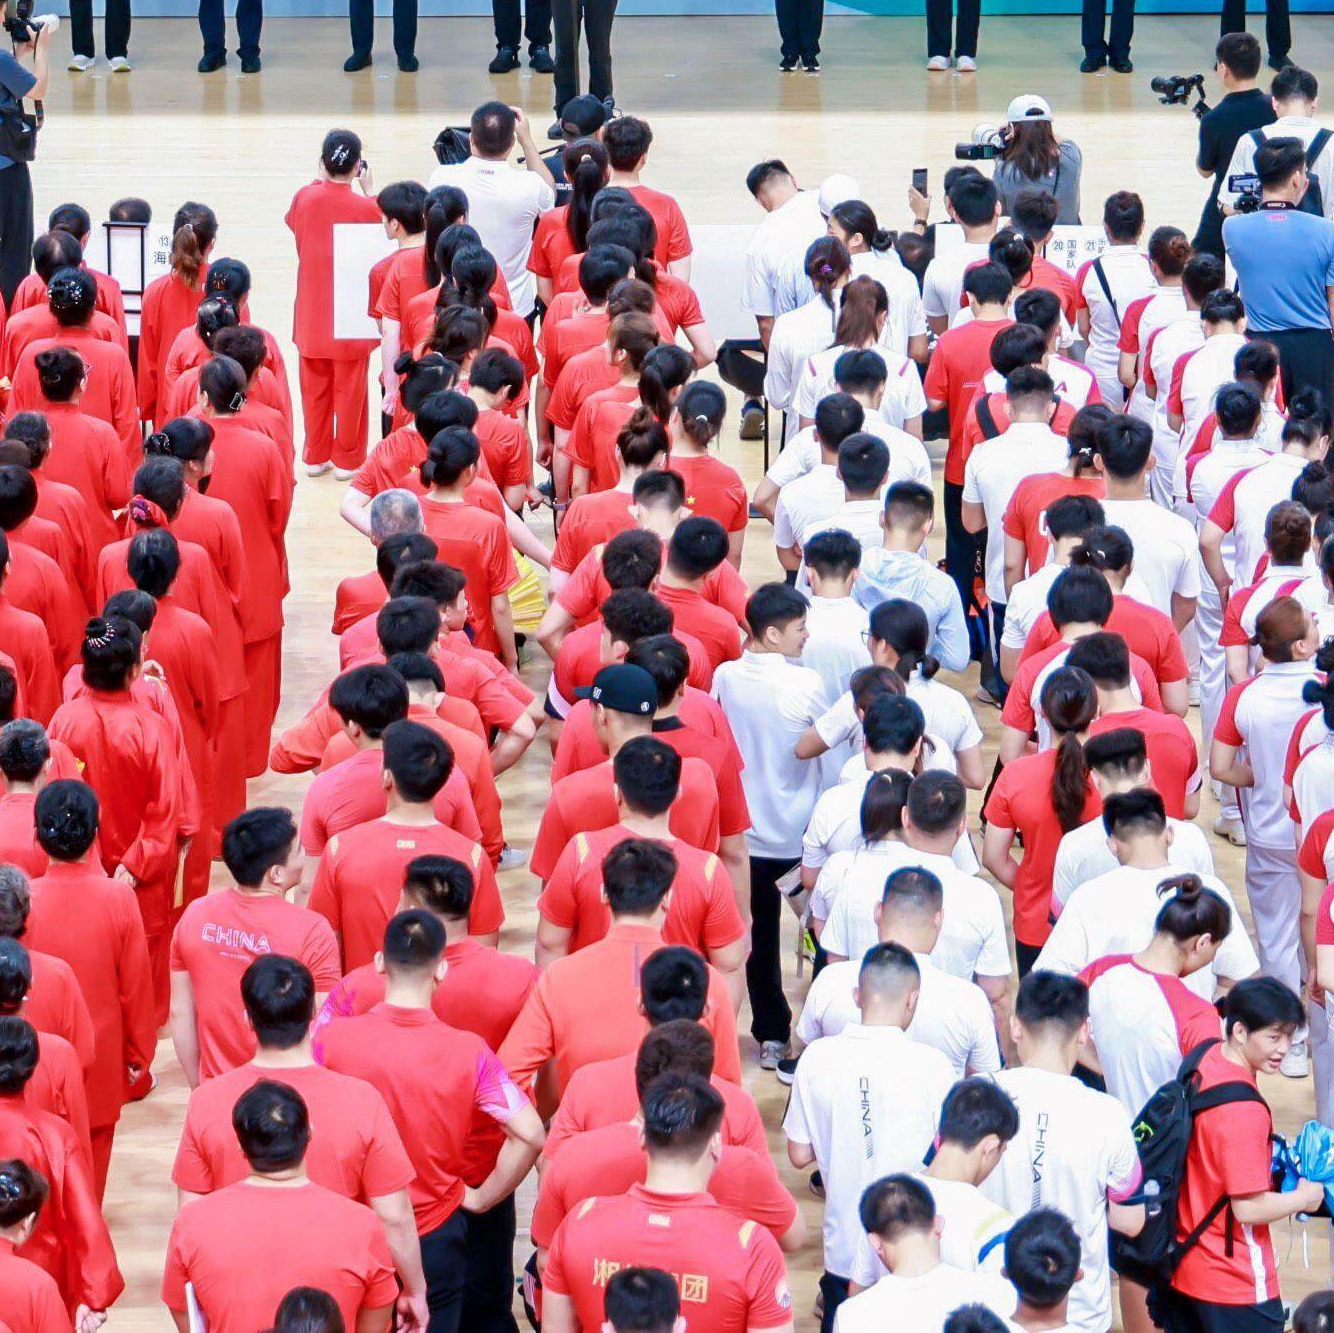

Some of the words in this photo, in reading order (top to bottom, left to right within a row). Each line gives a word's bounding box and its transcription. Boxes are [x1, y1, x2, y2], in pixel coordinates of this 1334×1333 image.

[198, 922, 272, 955] CHINA
[859, 1076, 872, 1138] CHINA
[1032, 1112, 1049, 1184] CHINA
